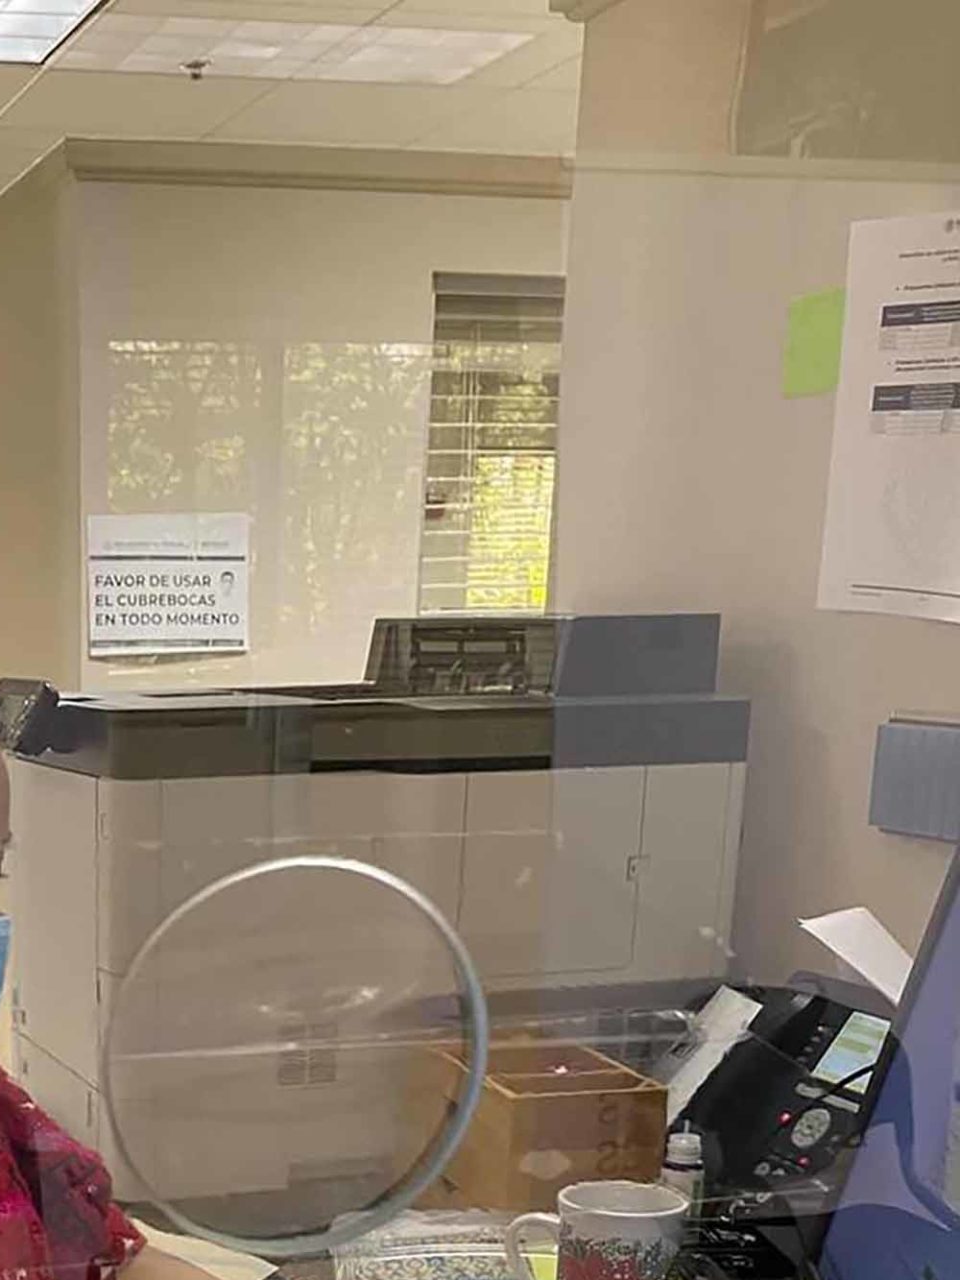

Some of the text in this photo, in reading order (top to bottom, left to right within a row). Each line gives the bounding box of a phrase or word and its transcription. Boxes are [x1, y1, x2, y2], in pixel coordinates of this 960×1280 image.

[95, 574, 212, 588] FAVOR DE USAR
[95, 593, 216, 607] EL CUBREBOCAS
[95, 612, 240, 626] EN TODO MOMENTO
